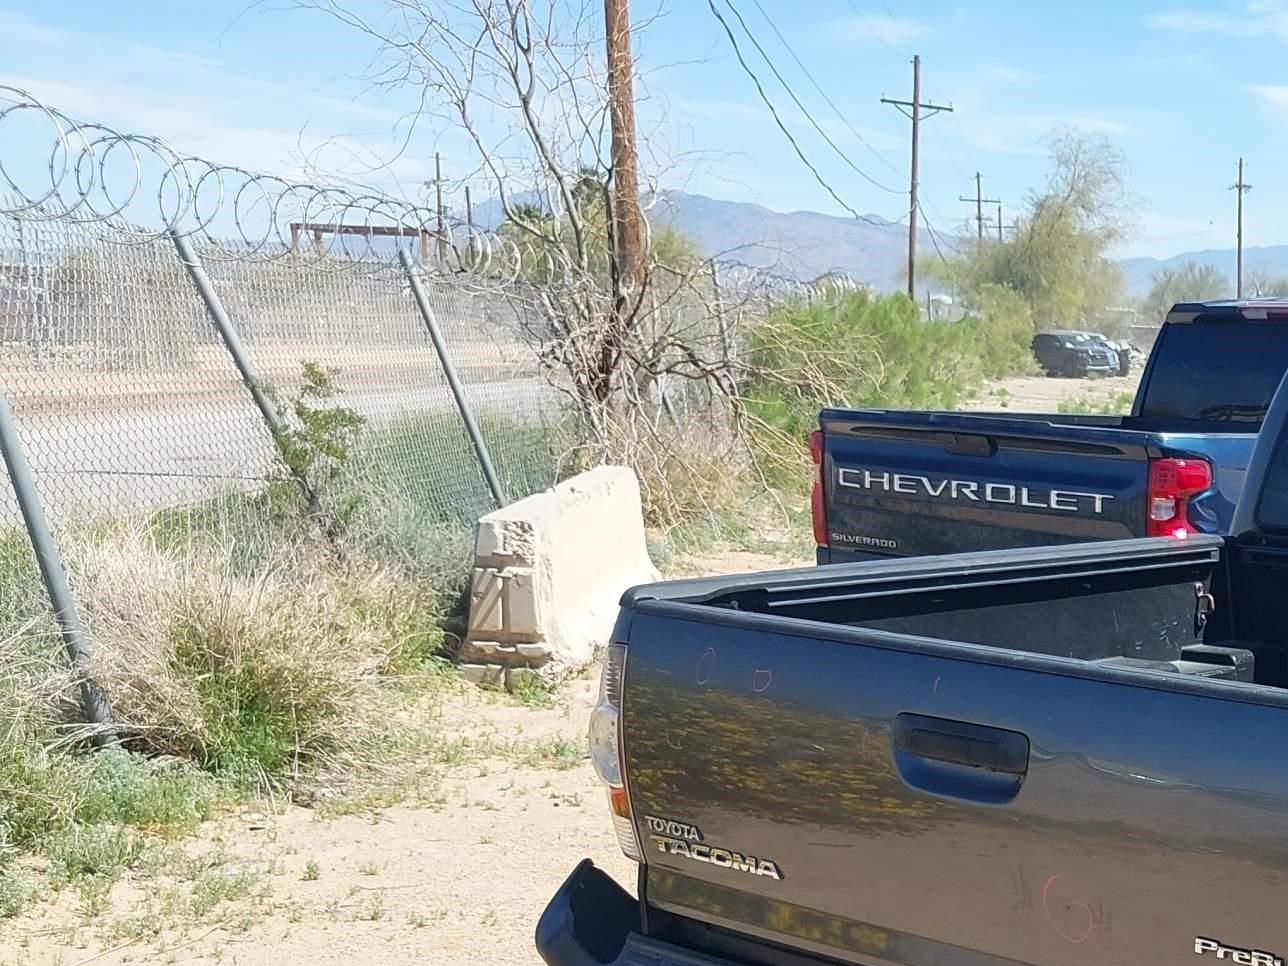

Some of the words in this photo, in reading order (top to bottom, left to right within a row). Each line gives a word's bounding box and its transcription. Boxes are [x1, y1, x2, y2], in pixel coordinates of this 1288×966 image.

[838, 466, 1115, 515] CHEVROLET
[832, 532, 897, 549] SILVERADO
[644, 815, 704, 841] TOYOTA
[650, 835, 785, 881] TACOMA
